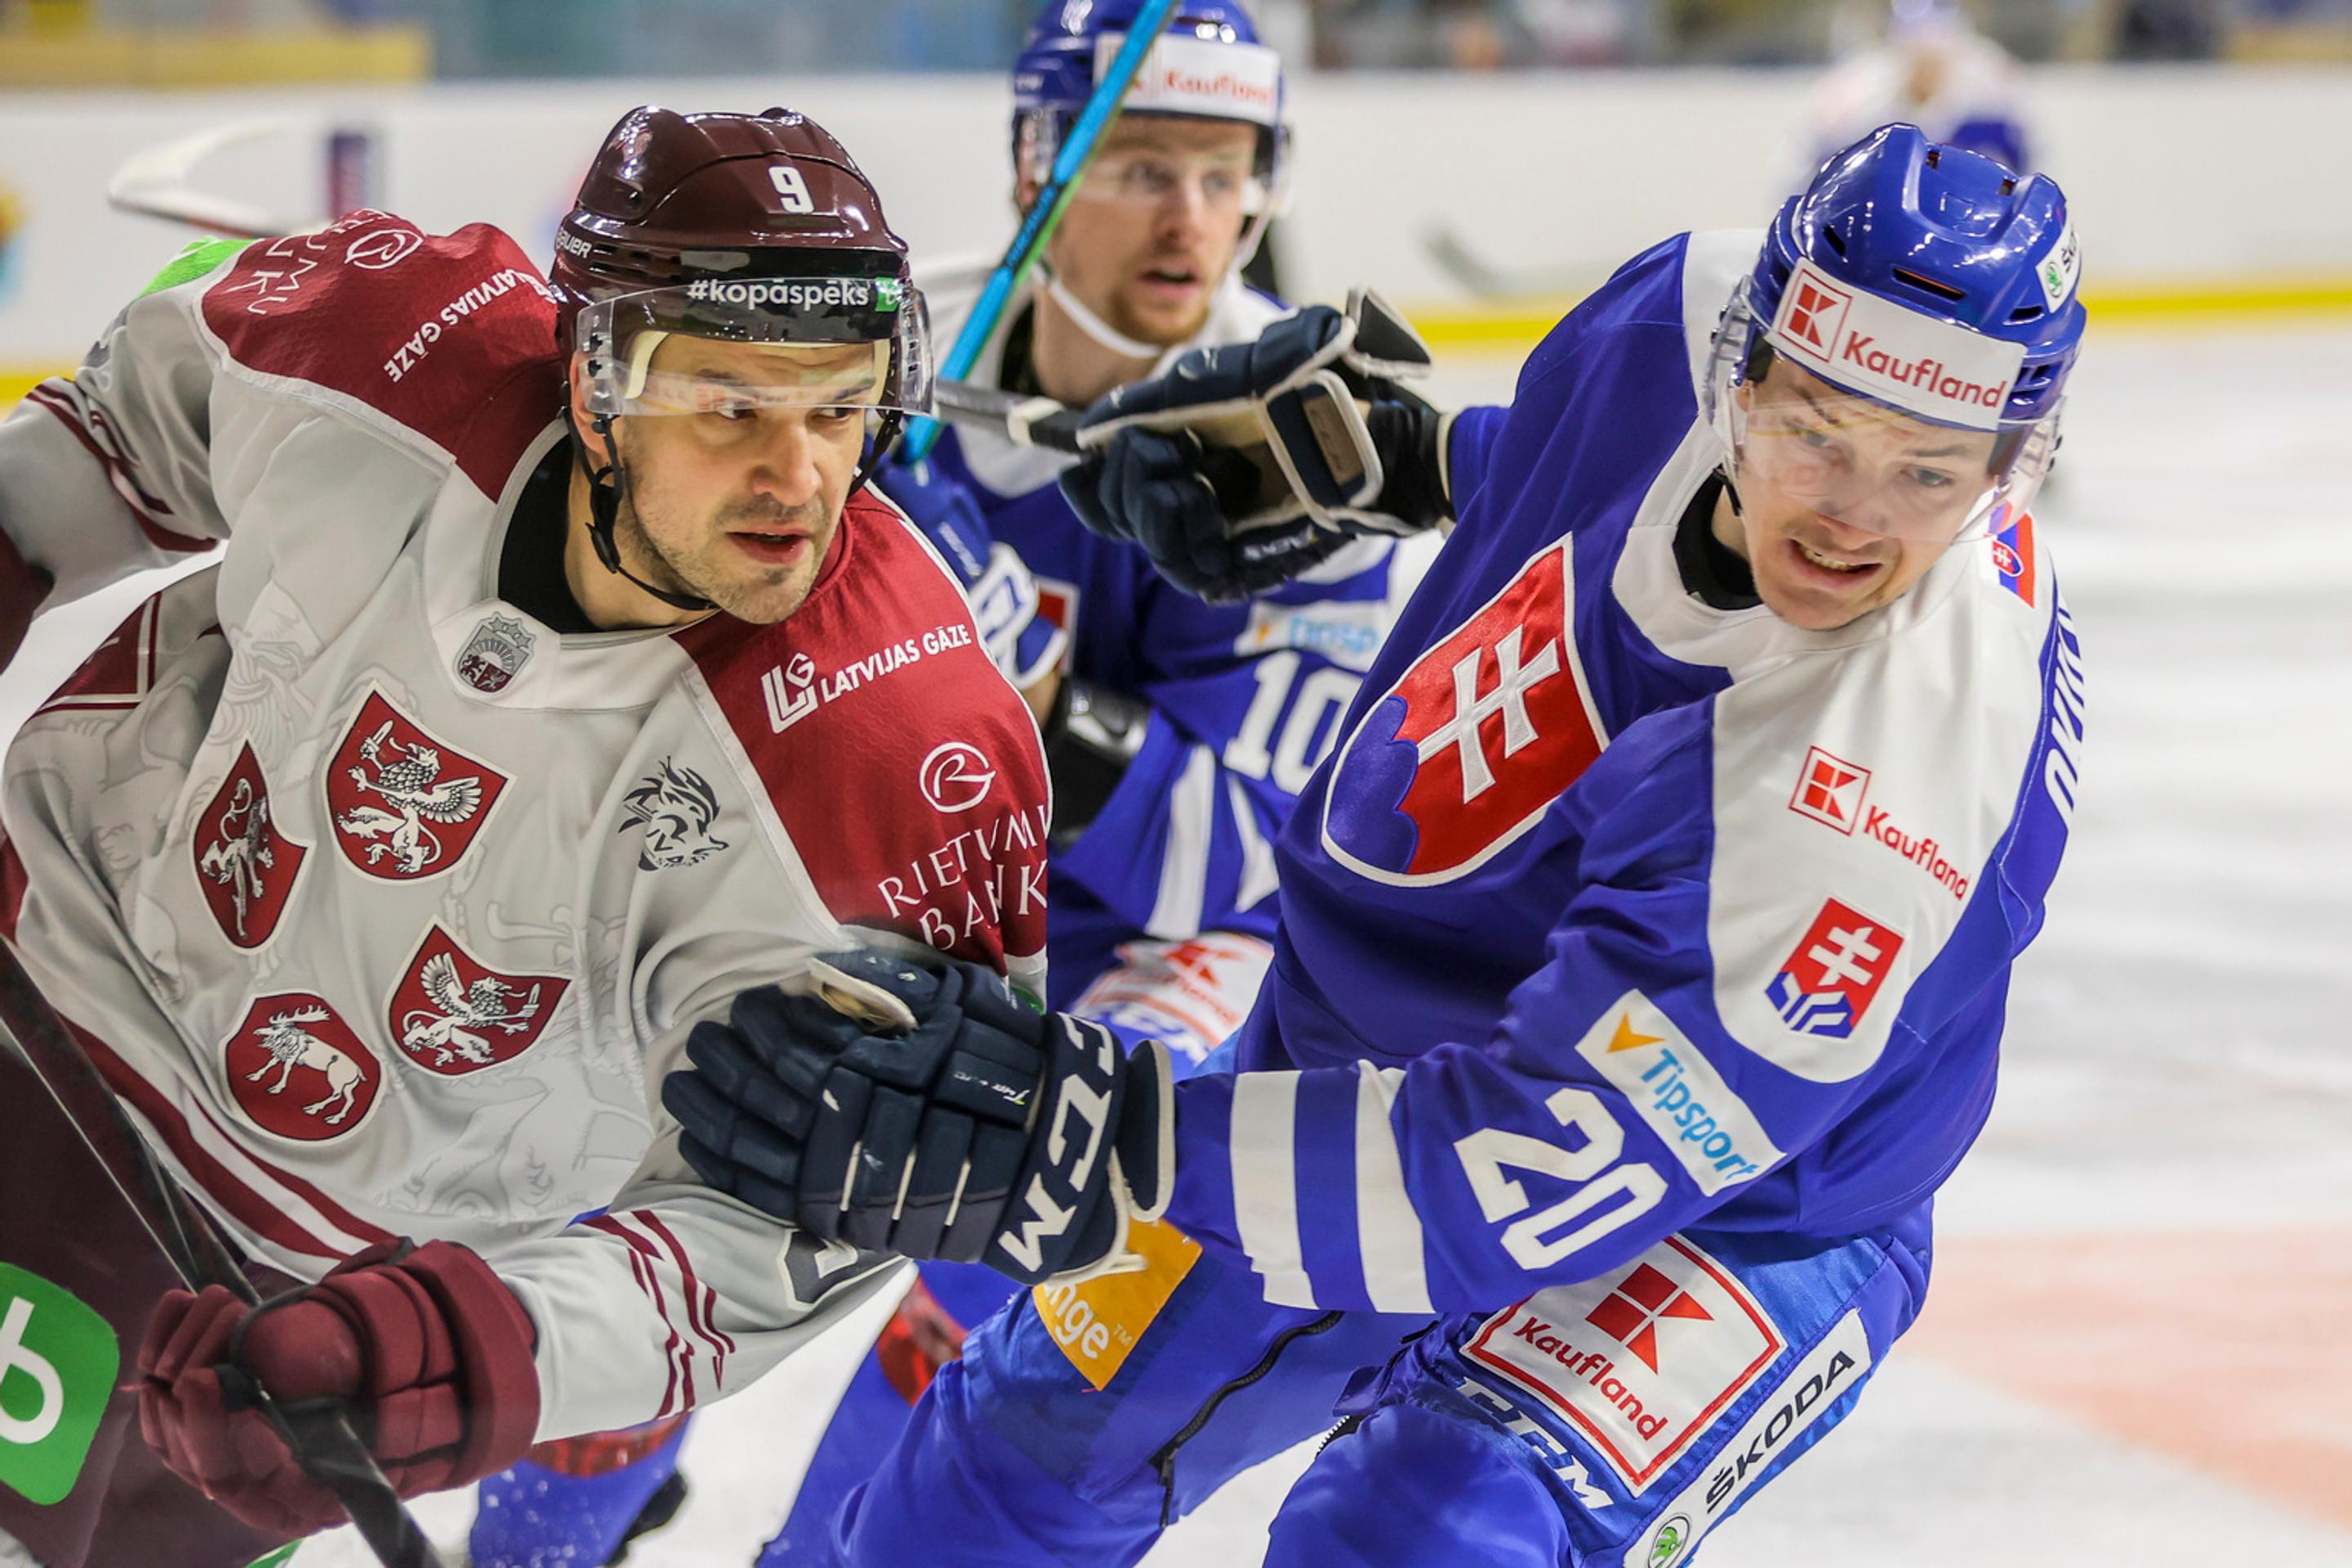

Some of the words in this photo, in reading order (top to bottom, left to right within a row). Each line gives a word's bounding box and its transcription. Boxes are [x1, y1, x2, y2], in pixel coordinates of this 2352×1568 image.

[768, 167, 814, 214] 9
[687, 278, 869, 312] #kopāspēks
[383, 322, 442, 383] GĀZE
[1843, 332, 2007, 408] Kaufland
[820, 639, 921, 703] LATVIJAS
[922, 624, 972, 656] GĀZE
[1223, 649, 1365, 795] 10
[1864, 804, 1969, 901] Kaufland
[997, 1011, 1115, 1273] CCM
[1642, 1049, 1758, 1181] Tipsport
[1454, 1087, 1669, 1271] 20
[1513, 1316, 1667, 1442] Kaufland
[1706, 1350, 1855, 1514] ŠKODA
